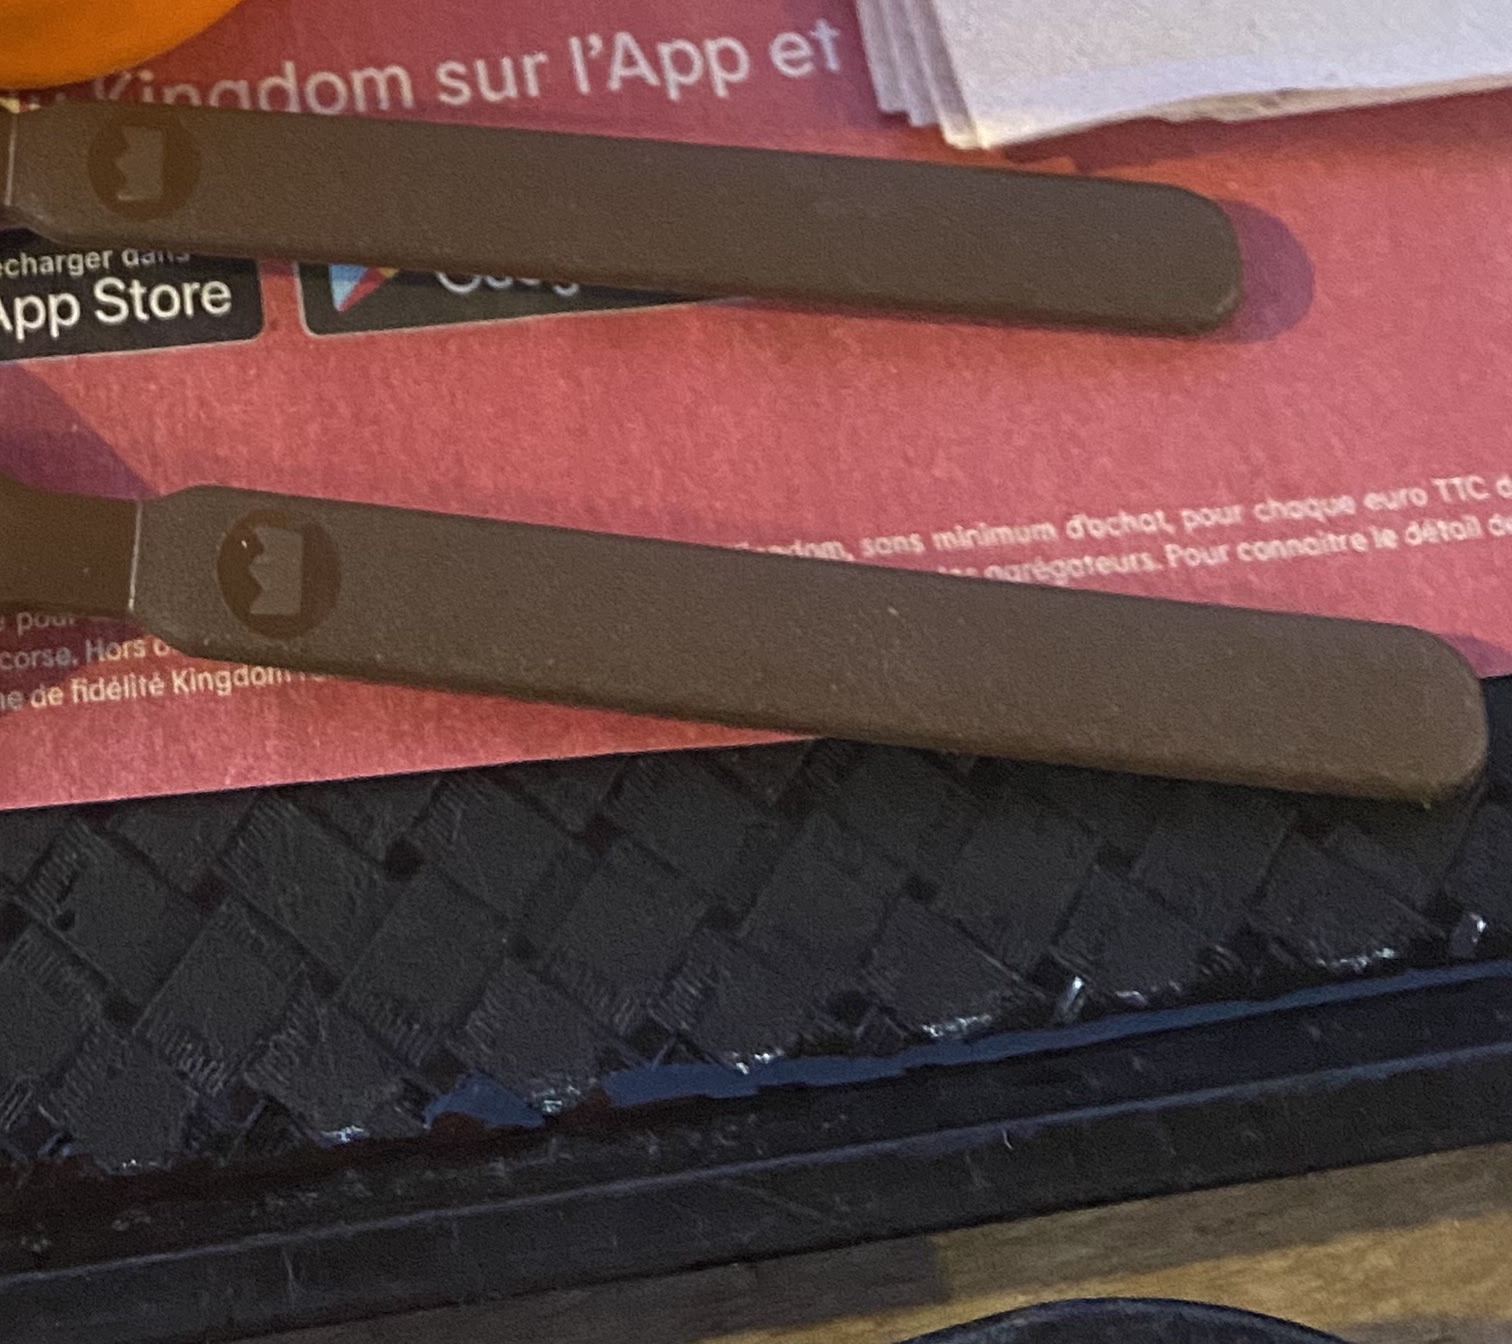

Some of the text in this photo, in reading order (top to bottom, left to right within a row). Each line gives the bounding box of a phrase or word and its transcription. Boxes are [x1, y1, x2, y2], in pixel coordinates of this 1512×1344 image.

[436, 50, 548, 106] sur
[569, 31, 750, 101] l'App
[769, 18, 841, 78] et
[94, 276, 232, 325] Store
[931, 520, 1058, 552] minimum
[1180, 504, 1243, 534] pour
[1252, 494, 1357, 524] chaque
[1363, 486, 1429, 513] euro
[1431, 474, 1491, 504] TTC
[1163, 542, 1229, 570] Pour
[1371, 524, 1399, 550] le
[85, 637, 148, 665] Hors
[30, 682, 64, 709] de
[70, 670, 165, 705] fidélité
